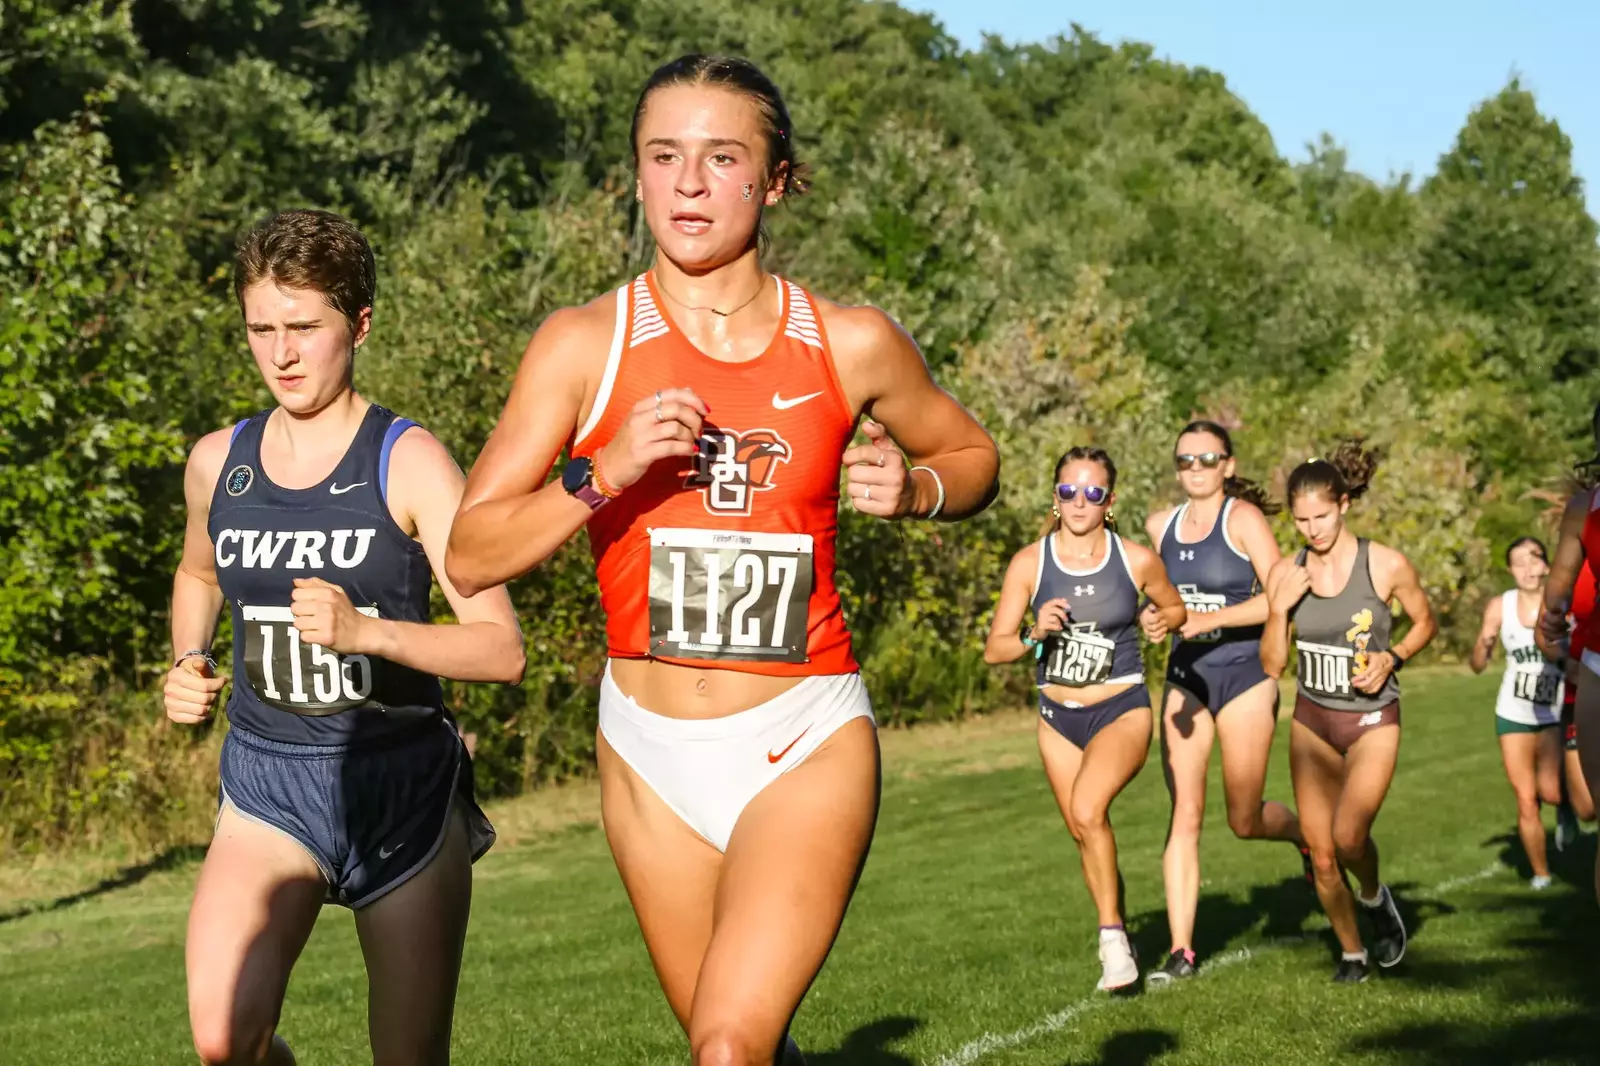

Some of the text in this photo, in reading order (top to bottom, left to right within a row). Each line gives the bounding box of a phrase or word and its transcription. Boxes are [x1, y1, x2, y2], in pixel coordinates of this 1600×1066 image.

[215, 529, 376, 569] CWRU
[667, 551, 798, 647] 1127
[1053, 641, 1108, 682] 1257
[1303, 651, 1350, 693] 1104
